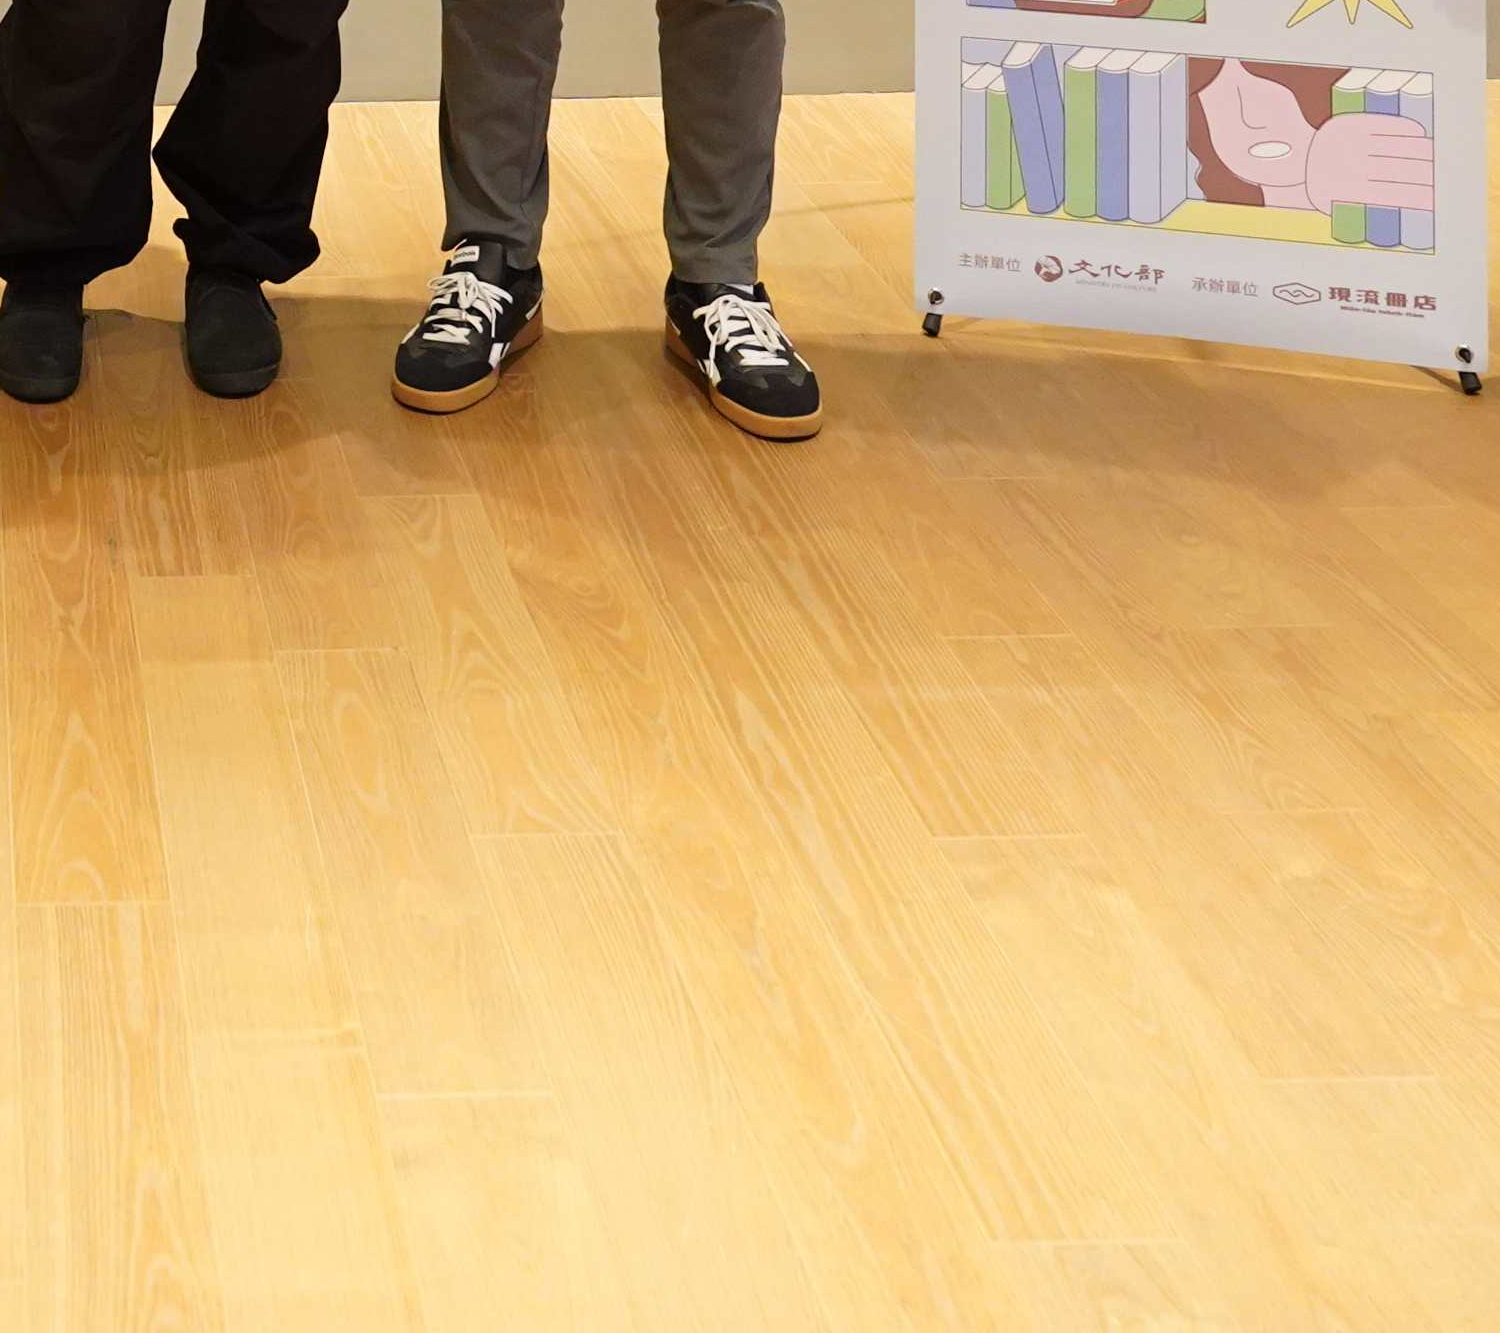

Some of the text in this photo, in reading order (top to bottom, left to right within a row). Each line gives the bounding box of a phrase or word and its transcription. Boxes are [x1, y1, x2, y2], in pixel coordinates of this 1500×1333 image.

[959, 253, 1165, 283] 主辦單位 文化部
[1192, 277, 1437, 310] 承辦單位 現流冊店
